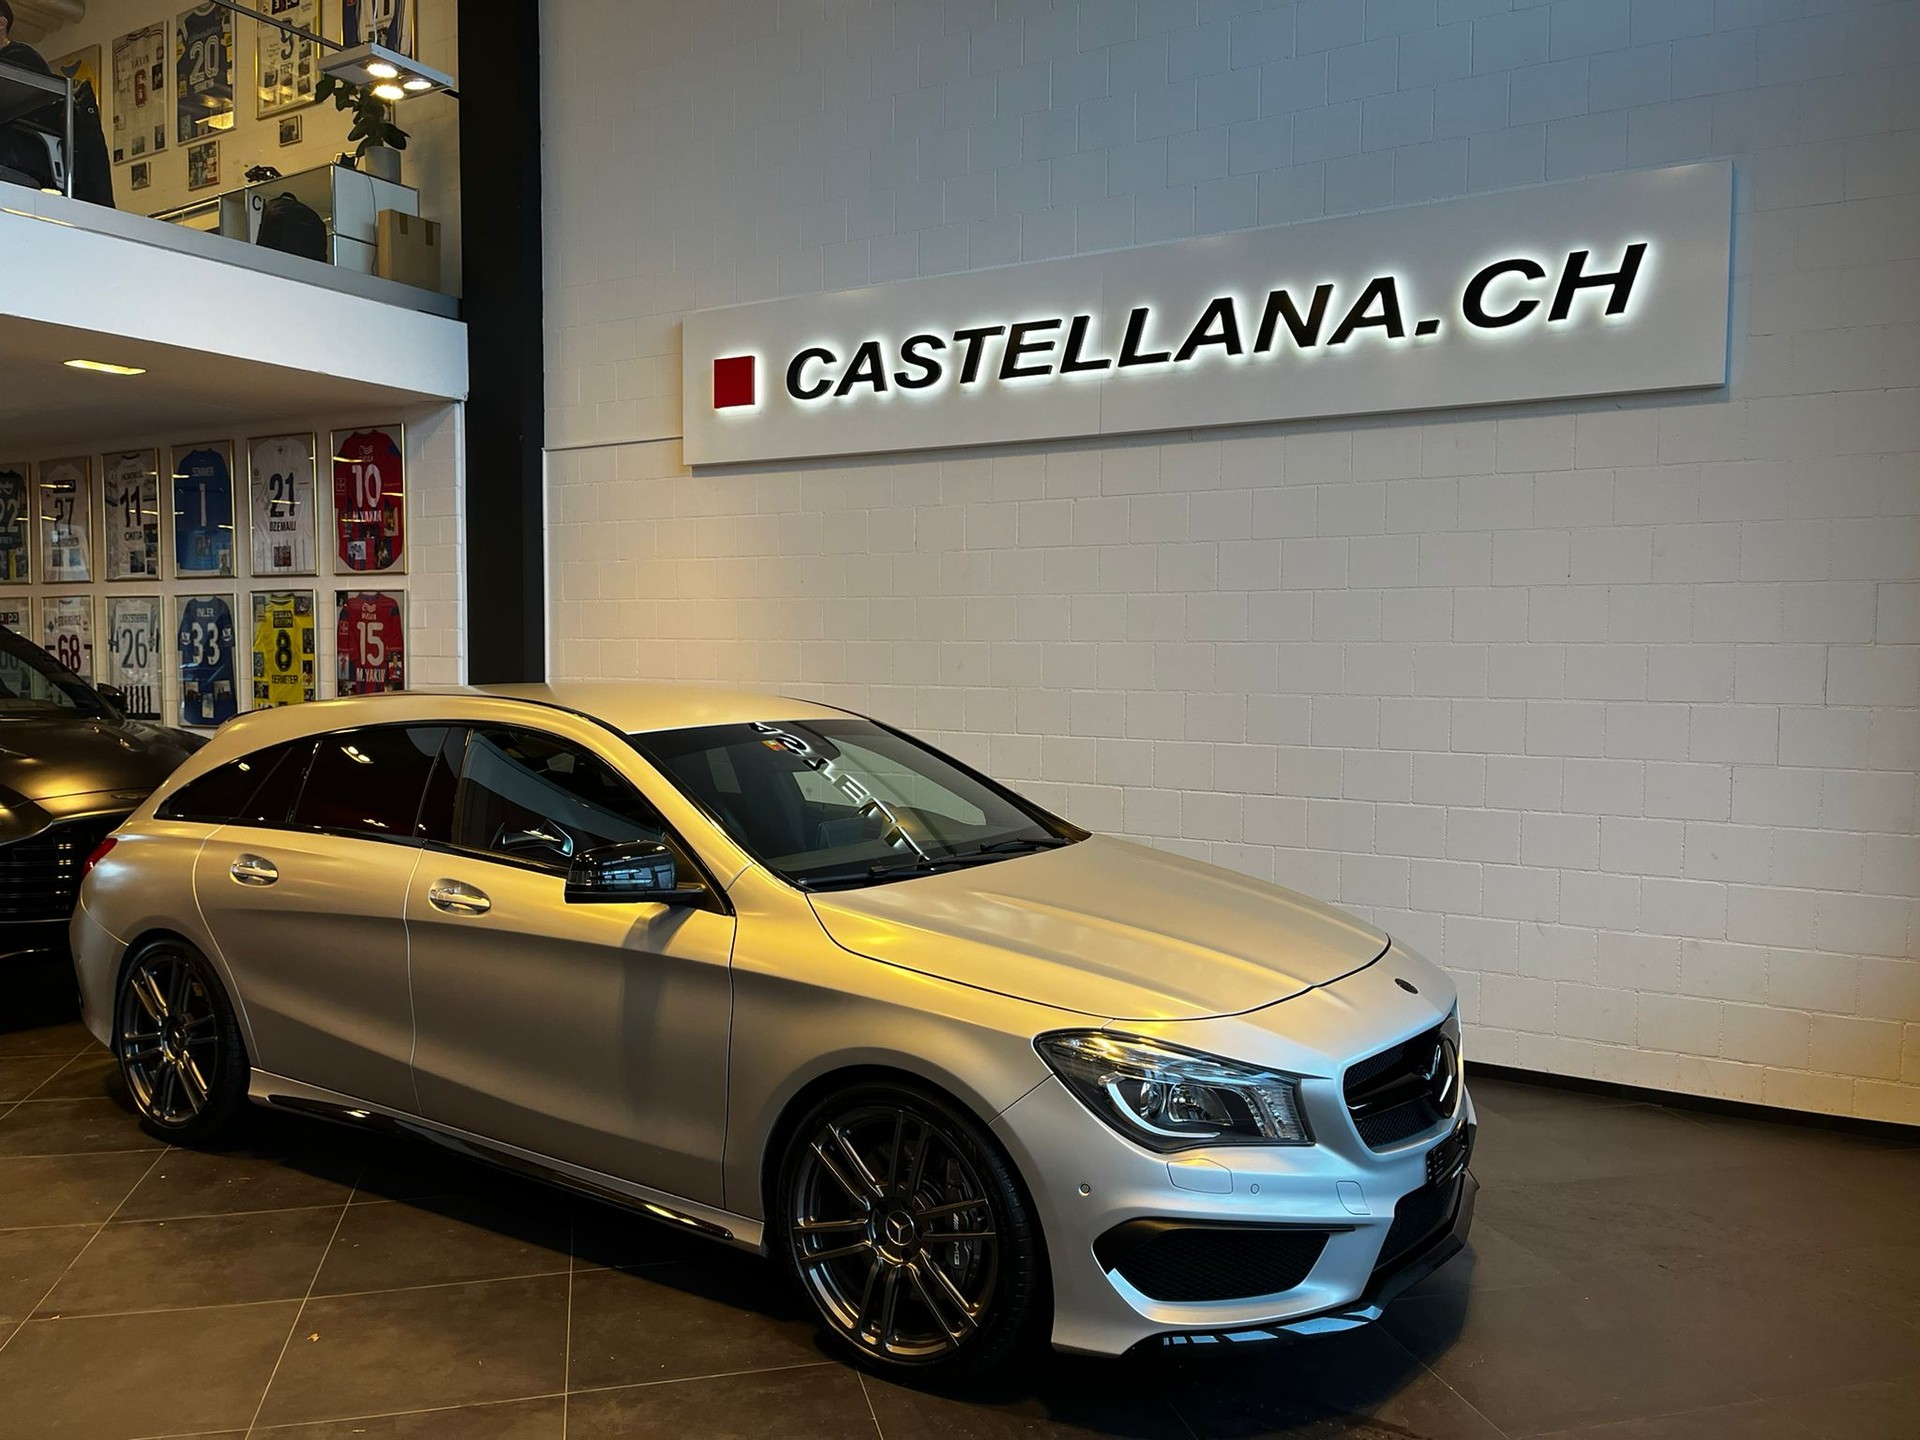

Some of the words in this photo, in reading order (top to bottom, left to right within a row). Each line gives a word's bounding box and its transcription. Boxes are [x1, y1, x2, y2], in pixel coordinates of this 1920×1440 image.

[189, 34, 219, 85] 20
[135, 69, 147, 108] 6
[785, 241, 1649, 403] CASTELLANA.CH
[119, 486, 141, 527] 11
[199, 483, 207, 527] 1
[269, 472, 295, 518] 21
[352, 464, 382, 508] 10
[55, 497, 74, 535] 27
[58, 634, 81, 673] 68
[121, 629, 148, 668] 26
[191, 622, 220, 665] 33
[275, 629, 292, 672] 8
[356, 621, 384, 666] 15
